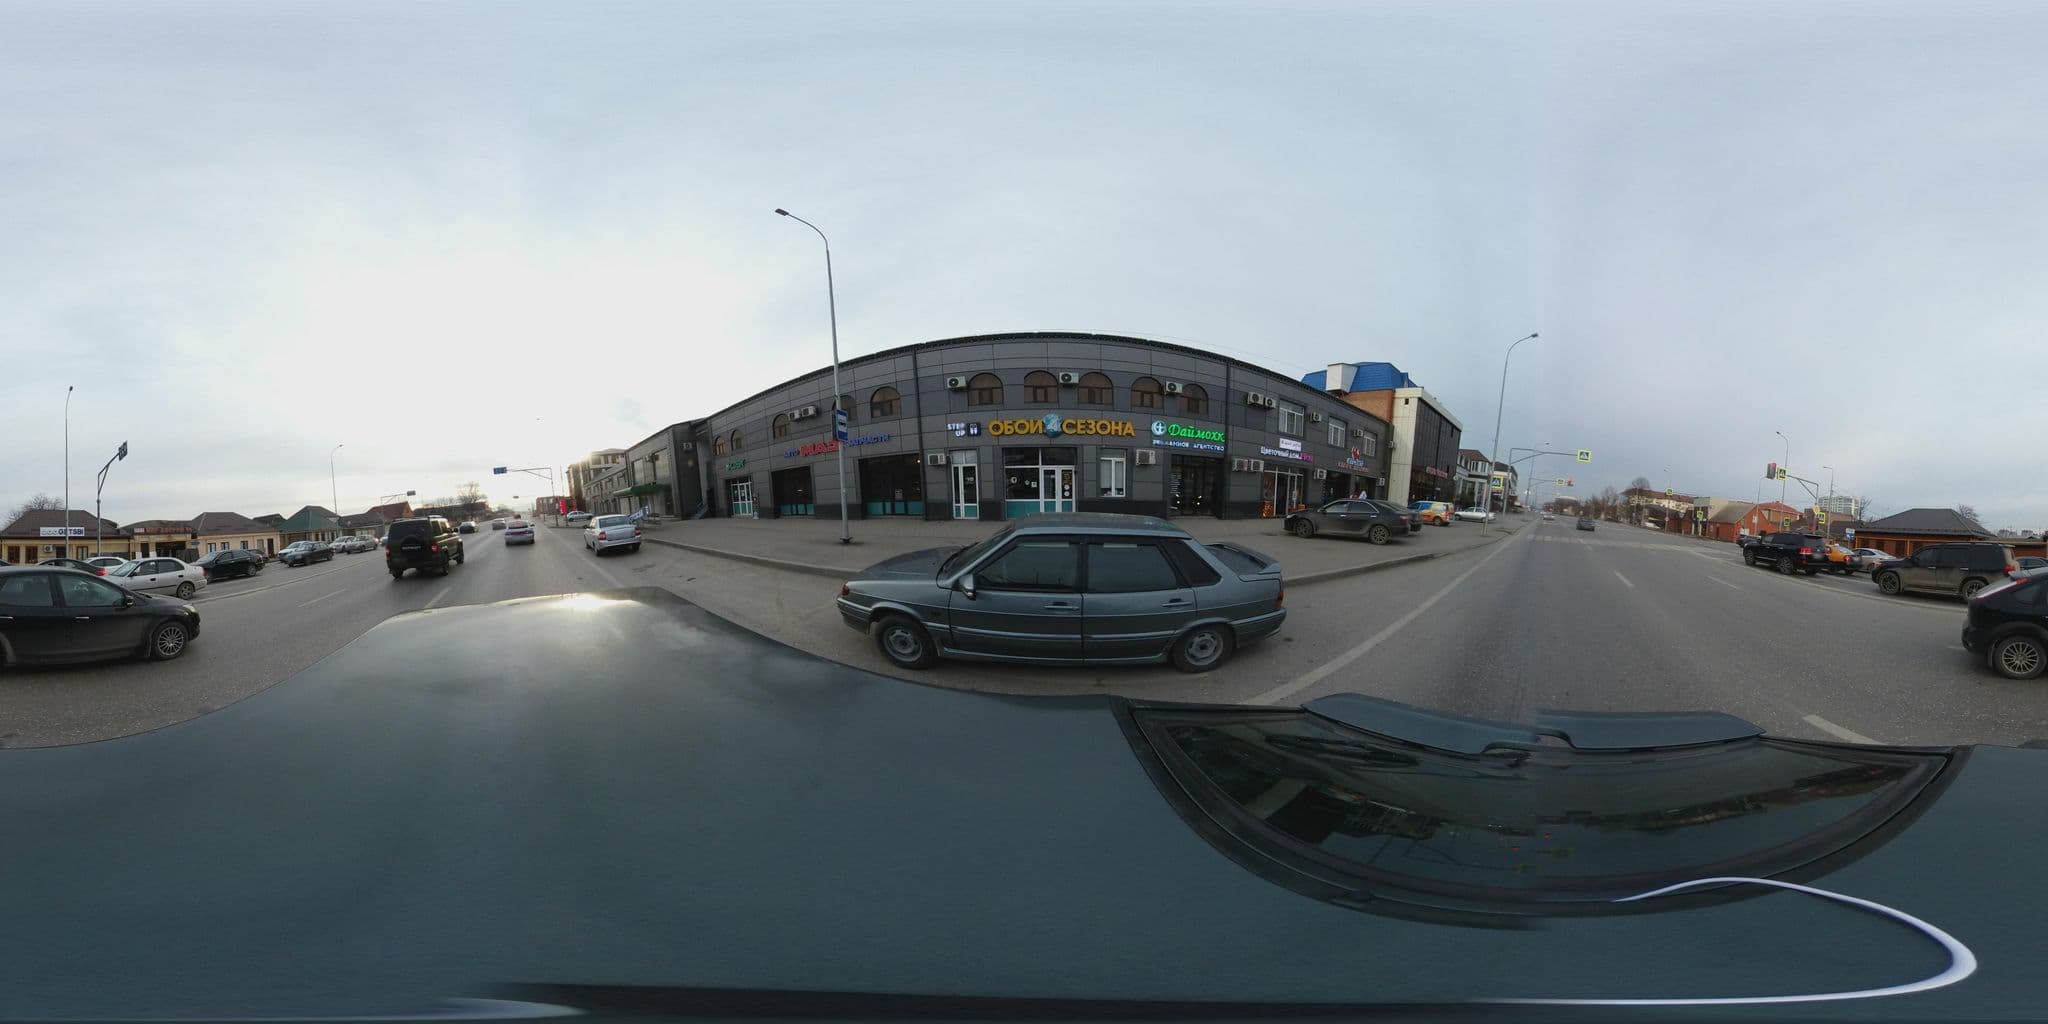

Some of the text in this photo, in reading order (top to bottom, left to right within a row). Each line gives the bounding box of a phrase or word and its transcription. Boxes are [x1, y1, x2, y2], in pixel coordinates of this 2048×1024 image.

[988, 418, 1043, 436] ОБОИ
[1062, 419, 1136, 436] СЕЗОНА
[1168, 423, 1226, 443] Даймохк
[847, 434, 890, 447] АПЧАСТИ
